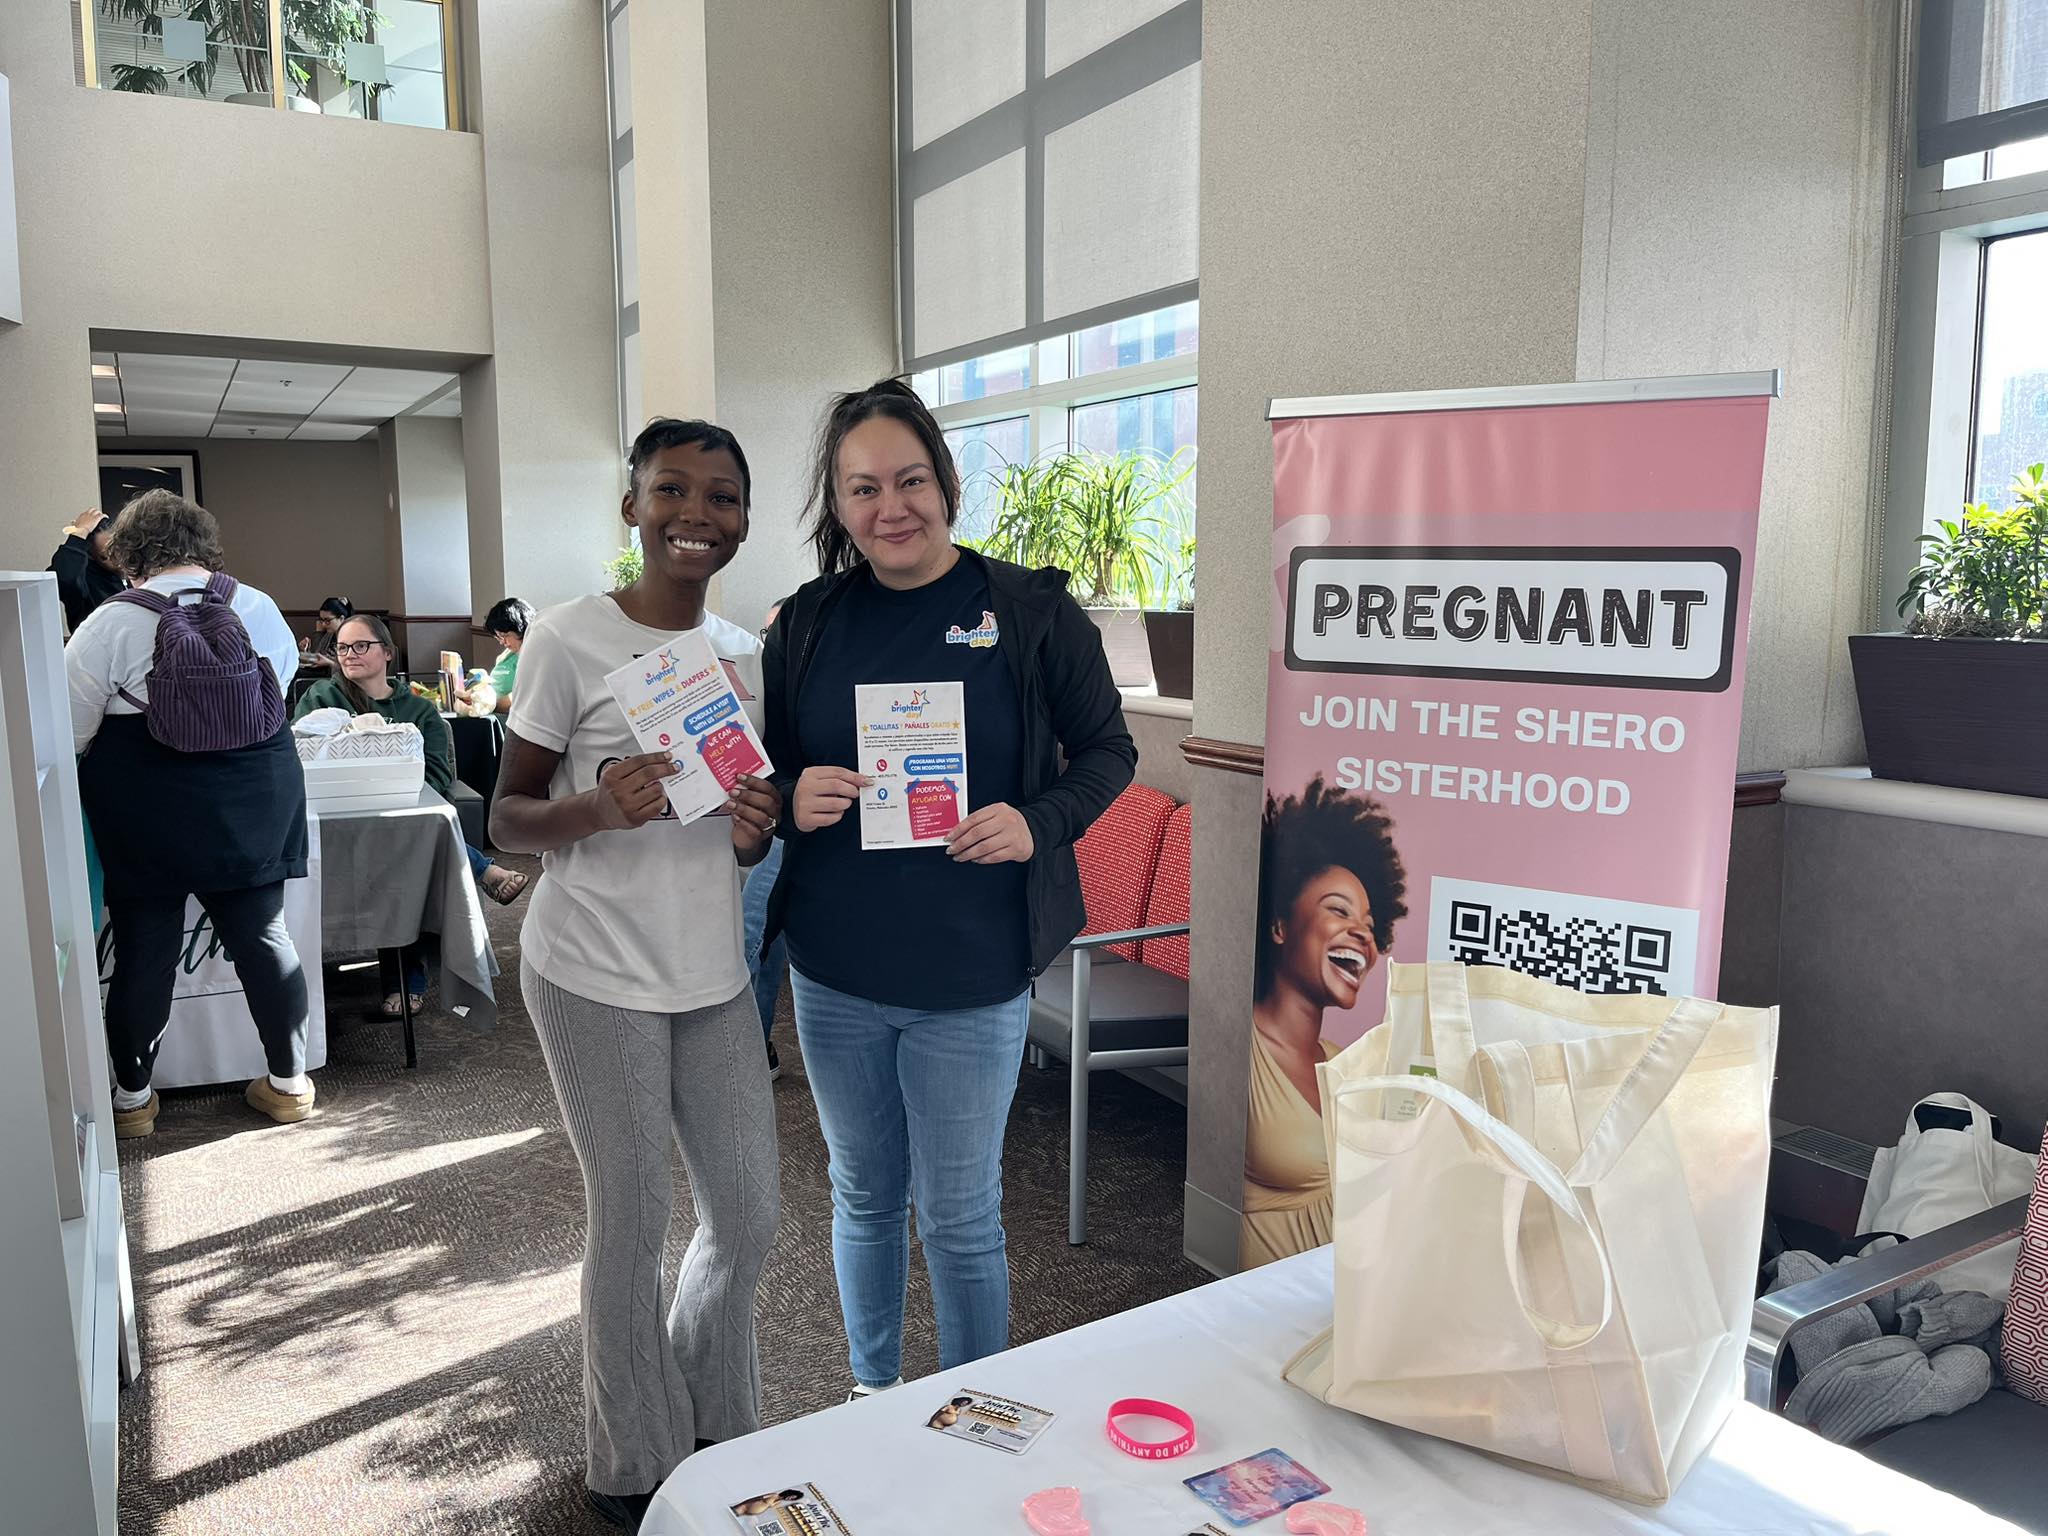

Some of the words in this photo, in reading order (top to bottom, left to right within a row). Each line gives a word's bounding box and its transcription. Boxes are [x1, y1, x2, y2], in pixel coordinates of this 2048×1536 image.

[1312, 583, 1708, 650] PREGNANT
[947, 630, 996, 642] brighter
[645, 667, 675, 685] brighter
[653, 688, 675, 704] WIPES
[681, 669, 710, 689] DIAPERS
[688, 708, 713, 725] SCHEDULE
[717, 698, 729, 709] VISIT
[891, 705, 921, 713] brighter
[693, 720, 707, 731] WITH
[869, 723, 899, 731] TOALLITAS
[905, 721, 929, 729] PAÑALES
[1299, 695, 1397, 732] JOIN
[1411, 700, 1501, 740] THE
[1514, 707, 1686, 754] SHERO
[708, 736, 719, 747] WE
[718, 728, 732, 739] CAN
[709, 746, 725, 759] HELP
[725, 734, 742, 749] WITH
[915, 785, 946, 794] PODEMOS
[1335, 756, 1631, 816] SISTERHOOD
[912, 795, 938, 804] AYUDAR
[939, 794, 952, 802] CON
[969, 1404, 1024, 1424] SHERO
[1155, 1447, 1169, 1458] DO
[1173, 1440, 1190, 1456] CAN
